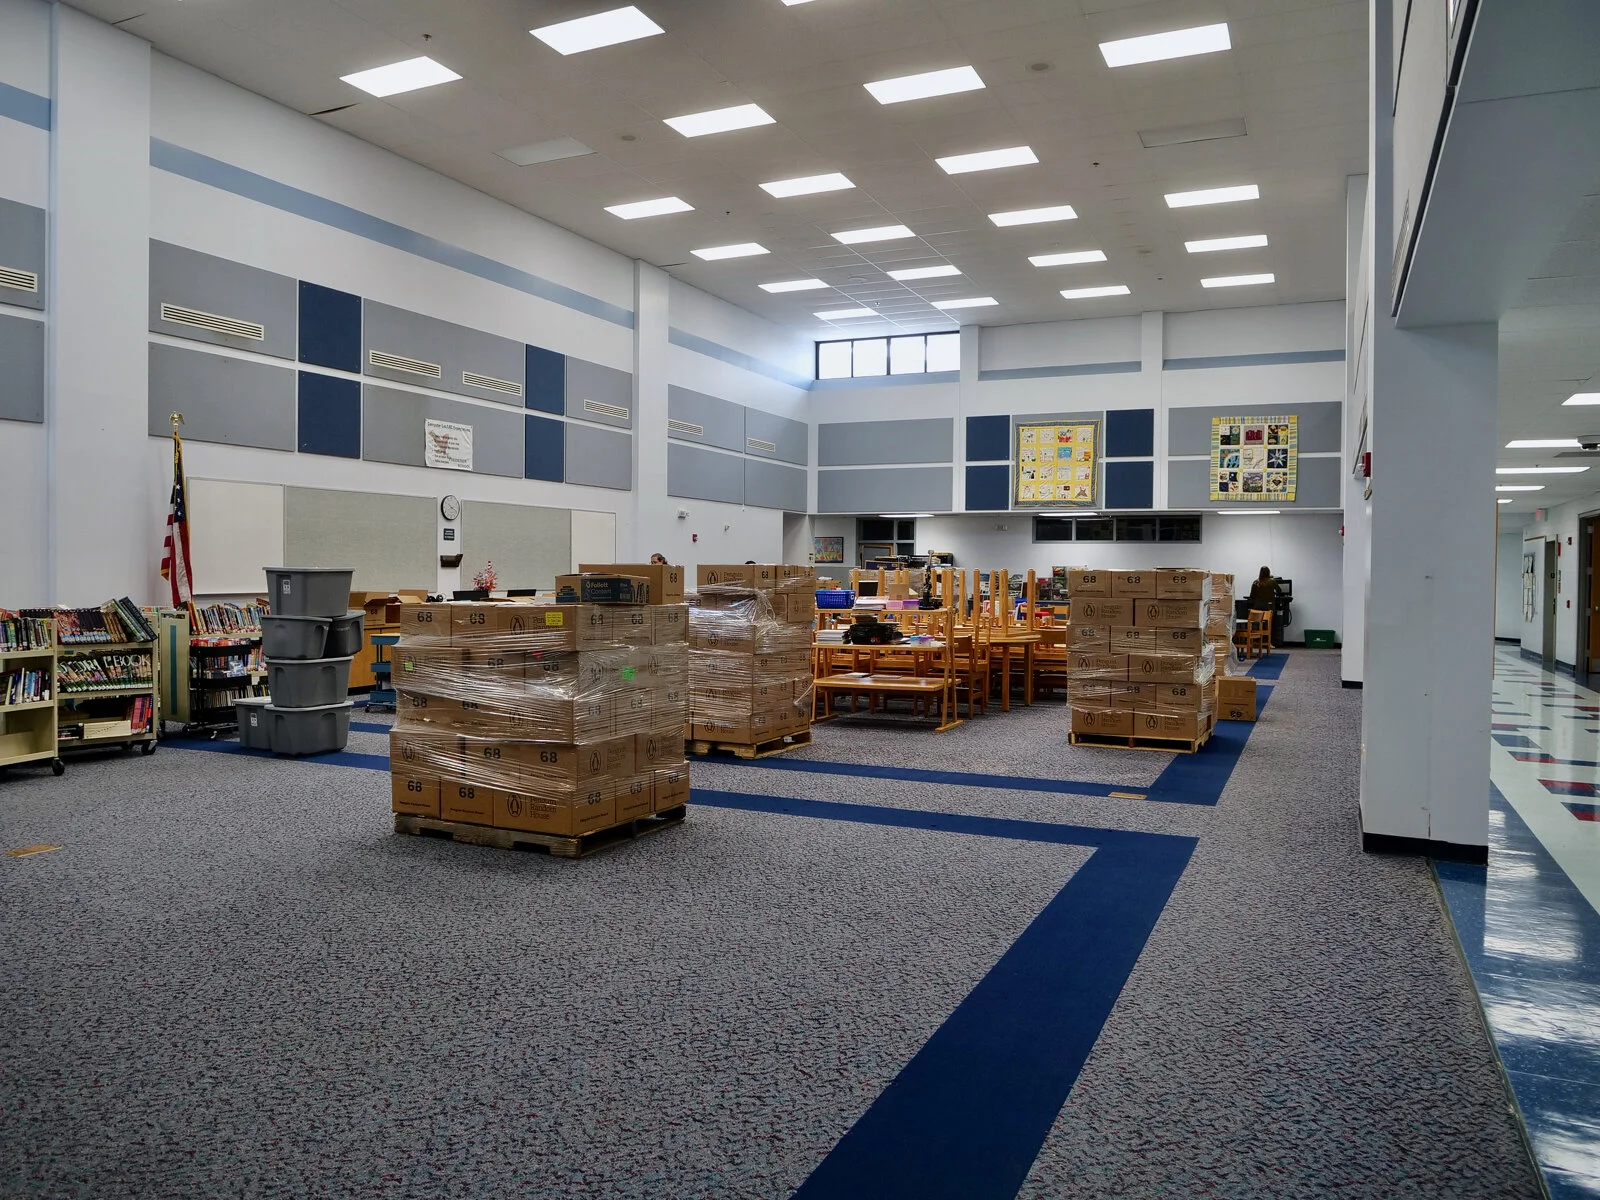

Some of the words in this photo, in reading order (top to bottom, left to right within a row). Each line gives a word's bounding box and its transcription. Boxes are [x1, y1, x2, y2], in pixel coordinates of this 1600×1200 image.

[669, 572, 678, 584] 68
[1083, 575, 1097, 584] 68
[1127, 576, 1141, 584] 68
[1172, 575, 1187, 584] 68
[417, 611, 433, 623] 68
[668, 612, 679, 623] 68
[1082, 628, 1095, 637] 68
[1126, 631, 1140, 639] 68
[1172, 631, 1187, 640] 68
[113, 654, 151, 667] BOOK
[1127, 686, 1140, 694] 68
[1172, 688, 1186, 696] 68
[484, 747, 501, 760] 68
[540, 751, 558, 763] 68
[407, 780, 422, 792] 68
[459, 787, 475, 799] 68
[588, 791, 602, 805] 68
[530, 803, 557, 812] Random
[530, 811, 550, 820] House
